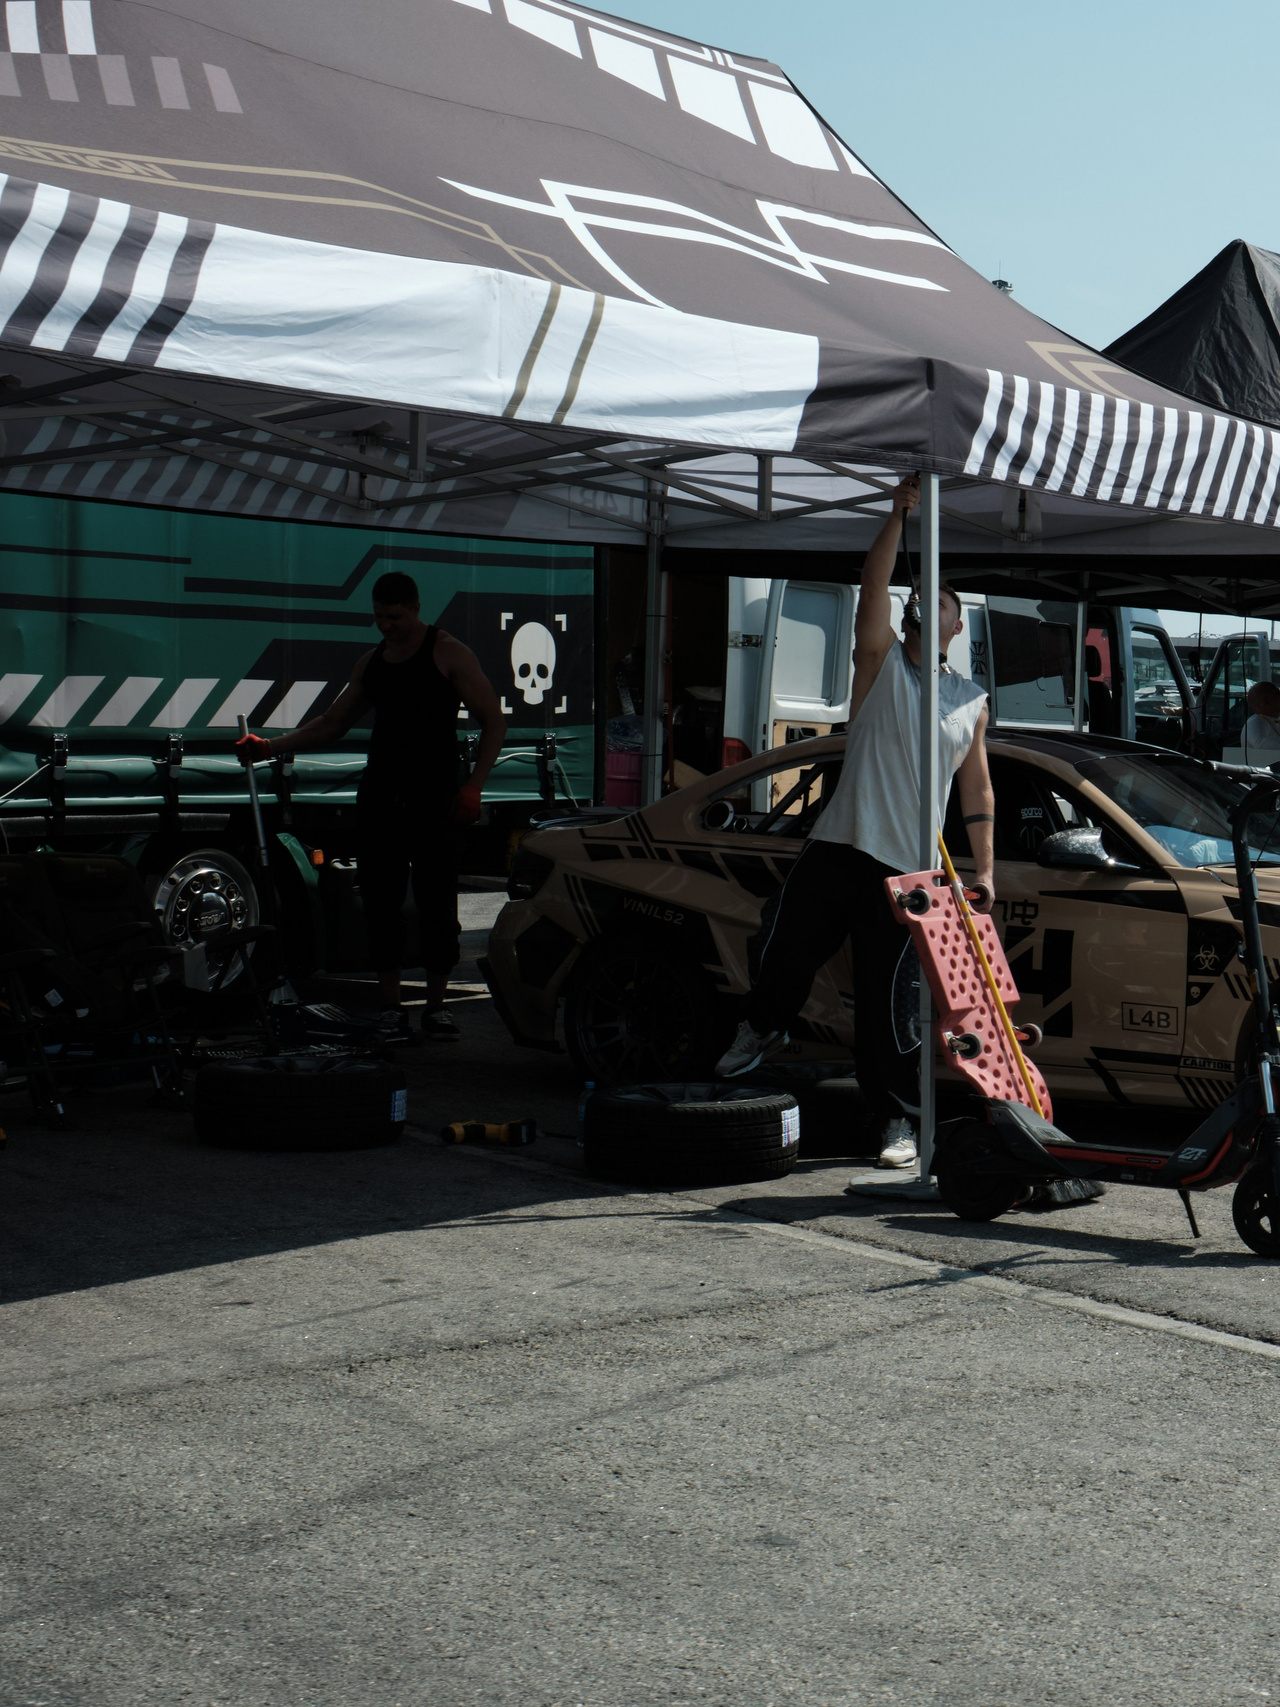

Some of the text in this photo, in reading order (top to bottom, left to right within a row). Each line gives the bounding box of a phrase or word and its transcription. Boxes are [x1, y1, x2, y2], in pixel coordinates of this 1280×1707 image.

[622, 896, 685, 926] VINIL52
[1128, 1008, 1171, 1029] L4B
[1182, 1058, 1232, 1071] CAUTION
